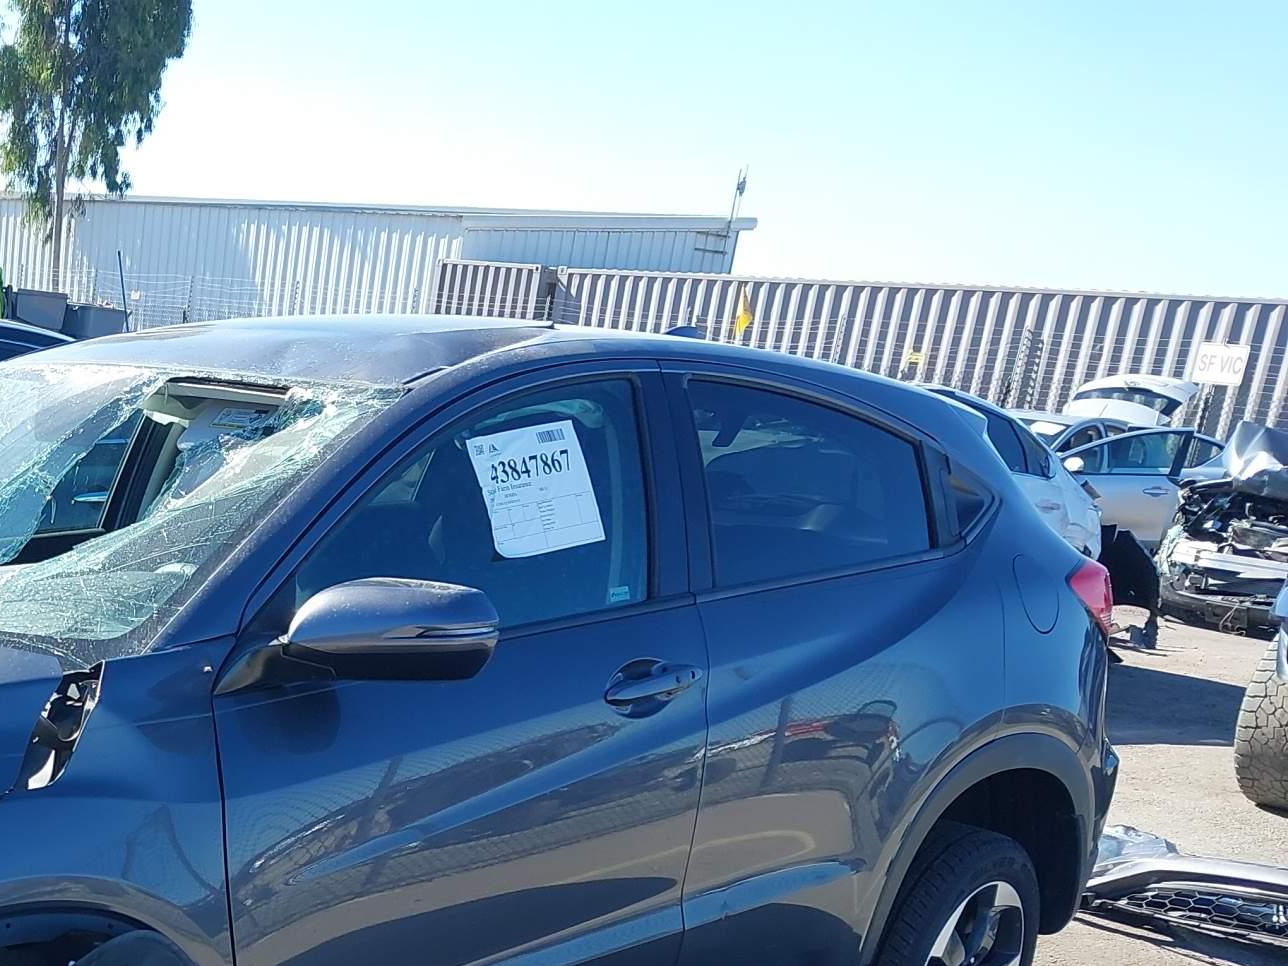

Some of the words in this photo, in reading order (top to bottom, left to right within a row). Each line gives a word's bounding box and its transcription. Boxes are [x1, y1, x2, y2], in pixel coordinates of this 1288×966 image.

[1198, 353, 1217, 372] SF
[1220, 356, 1243, 375] VIC
[490, 449, 571, 484] 43847867
